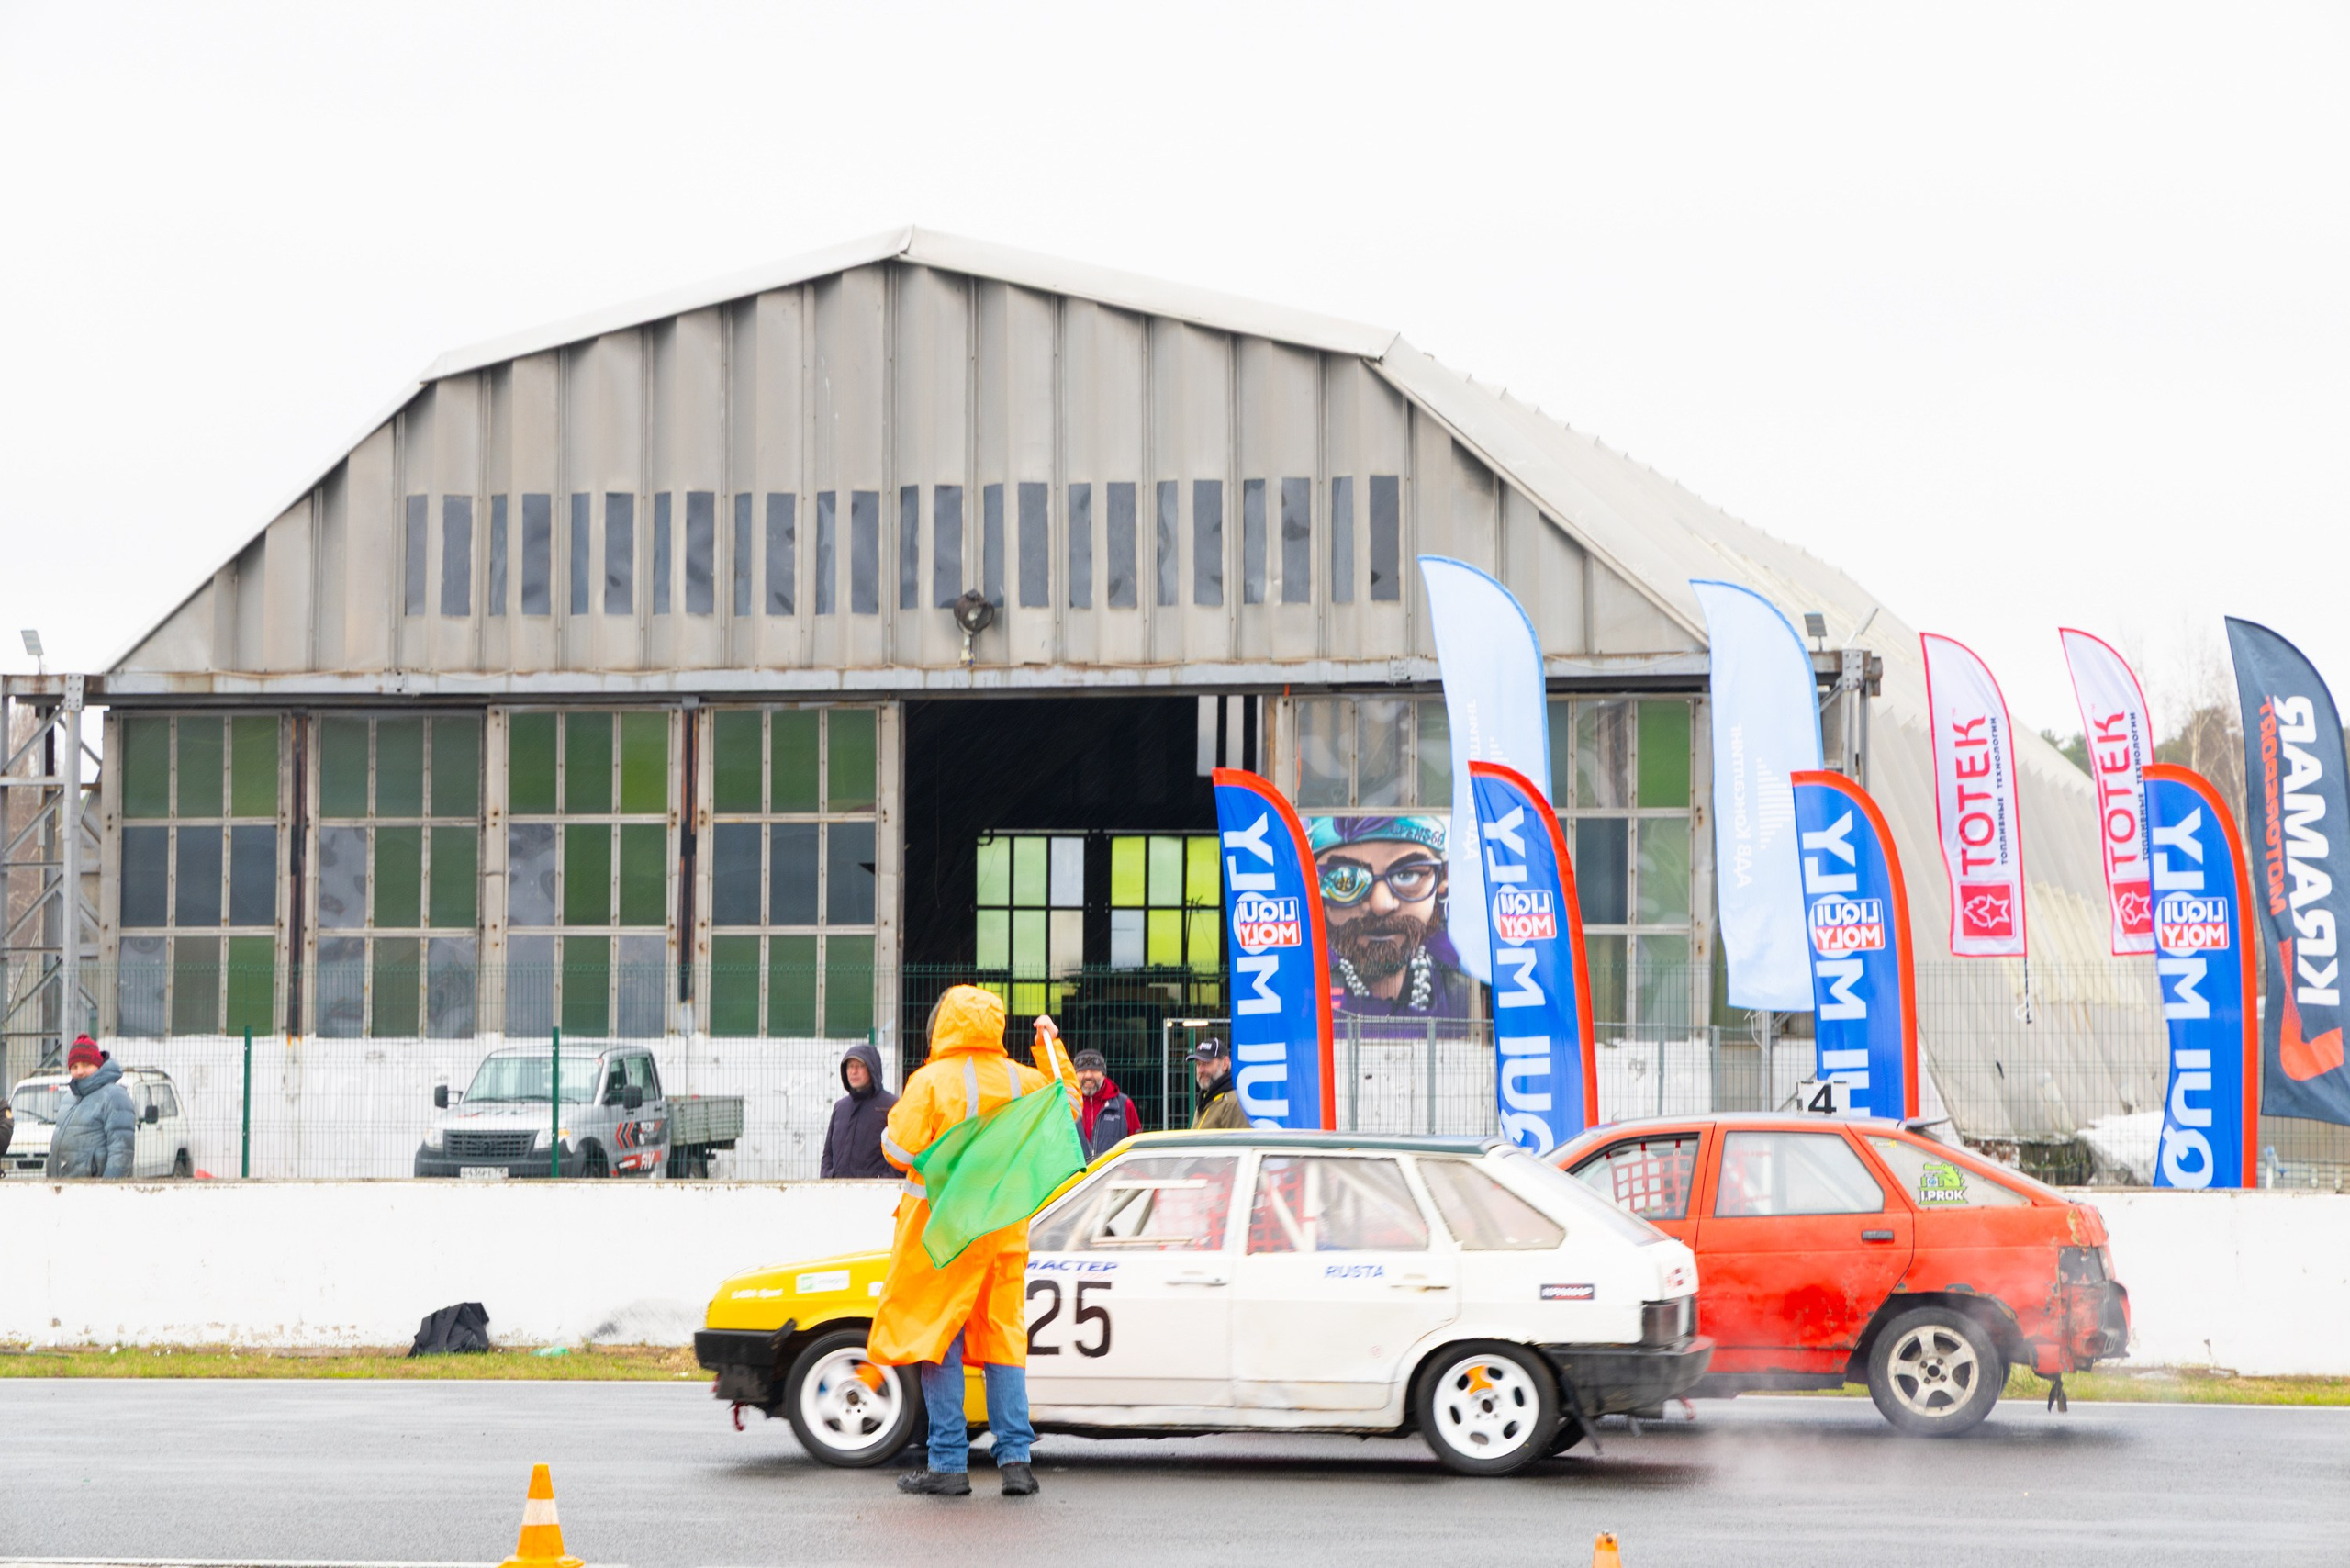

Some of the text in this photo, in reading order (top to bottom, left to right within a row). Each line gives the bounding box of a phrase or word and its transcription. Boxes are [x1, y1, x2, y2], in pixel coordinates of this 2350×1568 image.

[2130, 712, 2143, 785] ТЕХНОЛОГИИ
[1990, 717, 2008, 866] ТОПЛИВНЫЕ ТЕХНОЛОГИИ
[1808, 1083, 1837, 1114] 4
[1325, 1265, 1384, 1278] RUSTA
[1025, 1279, 1112, 1358] 25
